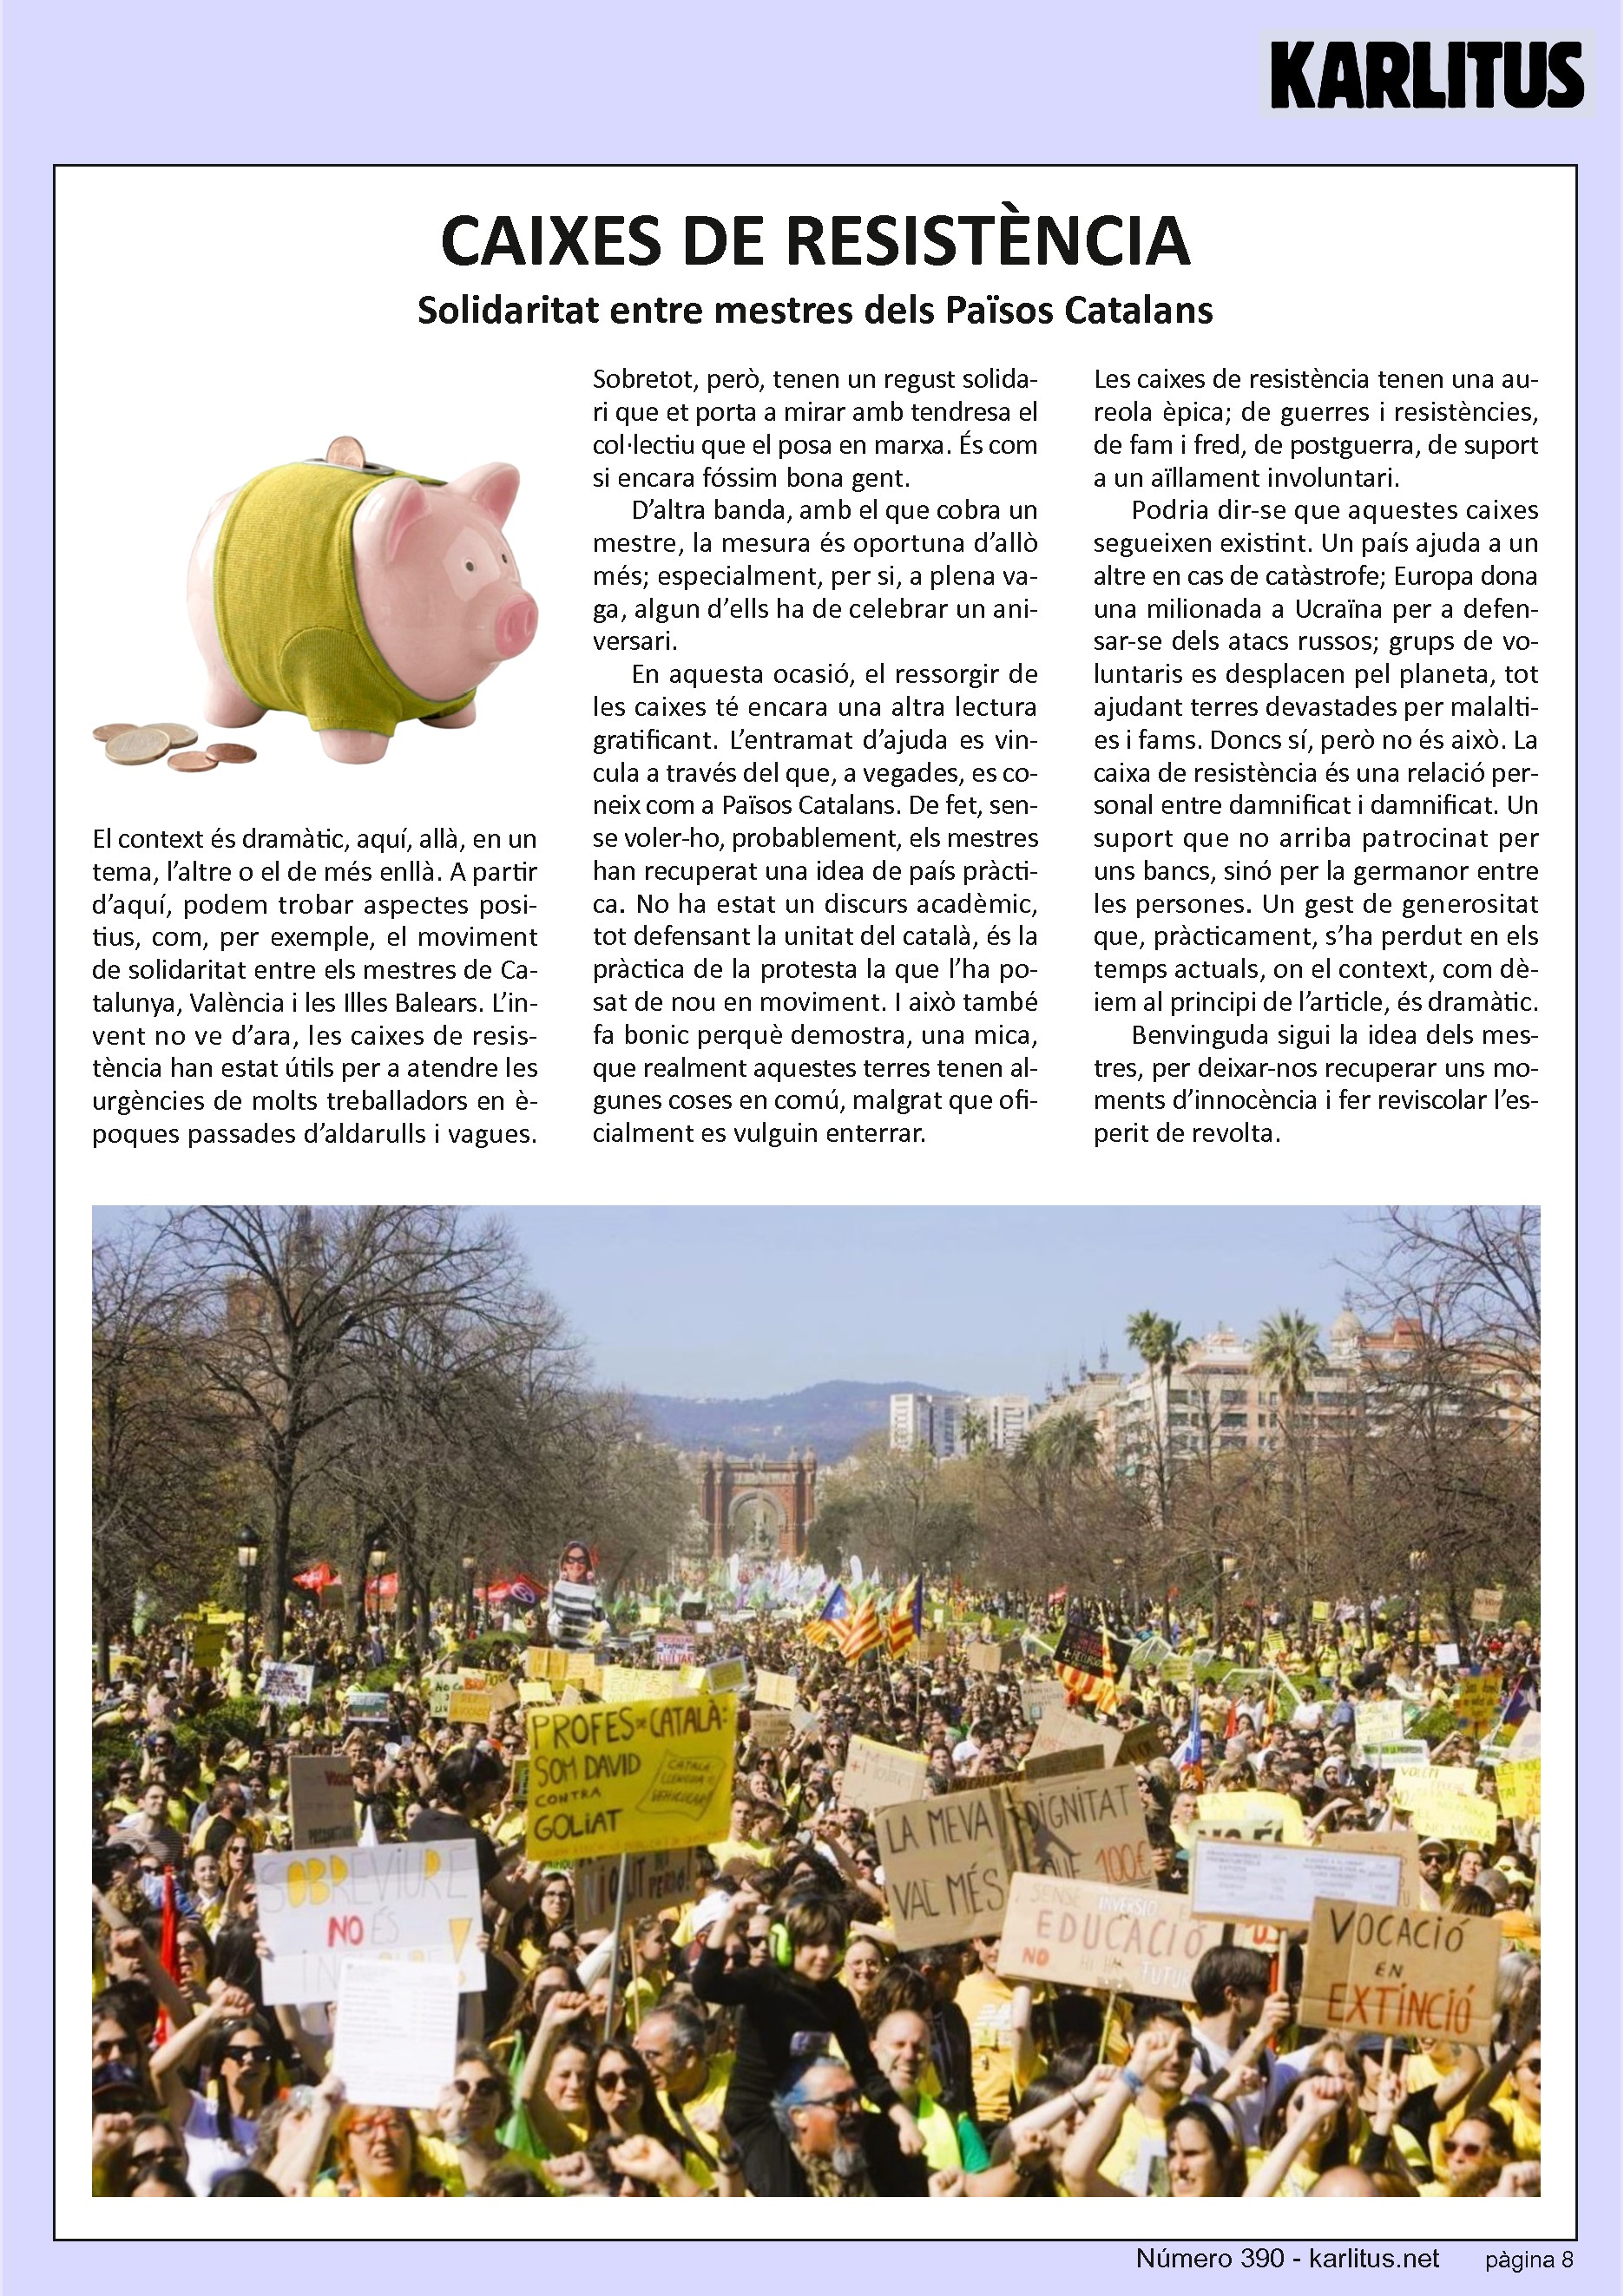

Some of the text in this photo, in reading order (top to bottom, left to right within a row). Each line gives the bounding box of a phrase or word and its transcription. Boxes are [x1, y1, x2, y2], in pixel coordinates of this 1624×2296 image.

[1272, 42, 1584, 108] KARLITUS
[443, 201, 1191, 266] CAIXES DE RESISTÈNCIA
[419, 294, 1213, 324] Solidaritat entre mestres dels Països Catalans
[594, 368, 1037, 393] Sobretot, però, tenen un regust solida-
[1096, 368, 1538, 388] Les caixes de resistència tenen una au-
[594, 467, 909, 492] si encara fóssim bona gent.
[1134, 499, 1538, 524] Podria dir-se que aquestes caixes
[634, 663, 1037, 688] En aquesta ocasió, el ressorgir de
[1095, 696, 1538, 721] ajudant terres devastades per malalti-
[95, 828, 536, 853] El context és dramàtic, aquí, allà, en un
[594, 827, 1038, 852] se voler-ho, probablement, els mestres
[1095, 860, 1538, 885] uns bancs, sinó per la germanor entre
[93, 992, 537, 1017] talunya, València i les Illes Balears. L’in-
[594, 991, 1037, 1011] sat de nou en moviment. I això també
[1134, 1024, 1538, 1049] Benvinguda sigui la idea dels mes-
[94, 1123, 536, 1148] poques passades d’aldarulls i vagues.
[594, 1122, 924, 1147] cialment es vulguin enterrar.
[1095, 1122, 1279, 1147] perit de revolta.
[531, 1706, 635, 1750] PROFES
[651, 1699, 728, 1738] CATALÀ:
[535, 1752, 641, 1788] SOM DAVID
[535, 1786, 602, 1808] CONTRA
[885, 1800, 995, 1854] LA MEVA
[892, 1861, 1006, 1921] VAL MÉS
[1029, 1884, 1082, 1908] SENSE
[328, 1914, 365, 1948] NO
[1036, 1909, 1208, 1960] EDUCACIÓ
[1022, 1946, 1051, 1967] NO
[1375, 1961, 1404, 1978] EN
[1138, 2248, 1232, 2267] Número
[1241, 2248, 1284, 2267] 390
[1311, 2248, 1439, 2267] karlitus.net
[1487, 2251, 1573, 2273] pàgina 8
